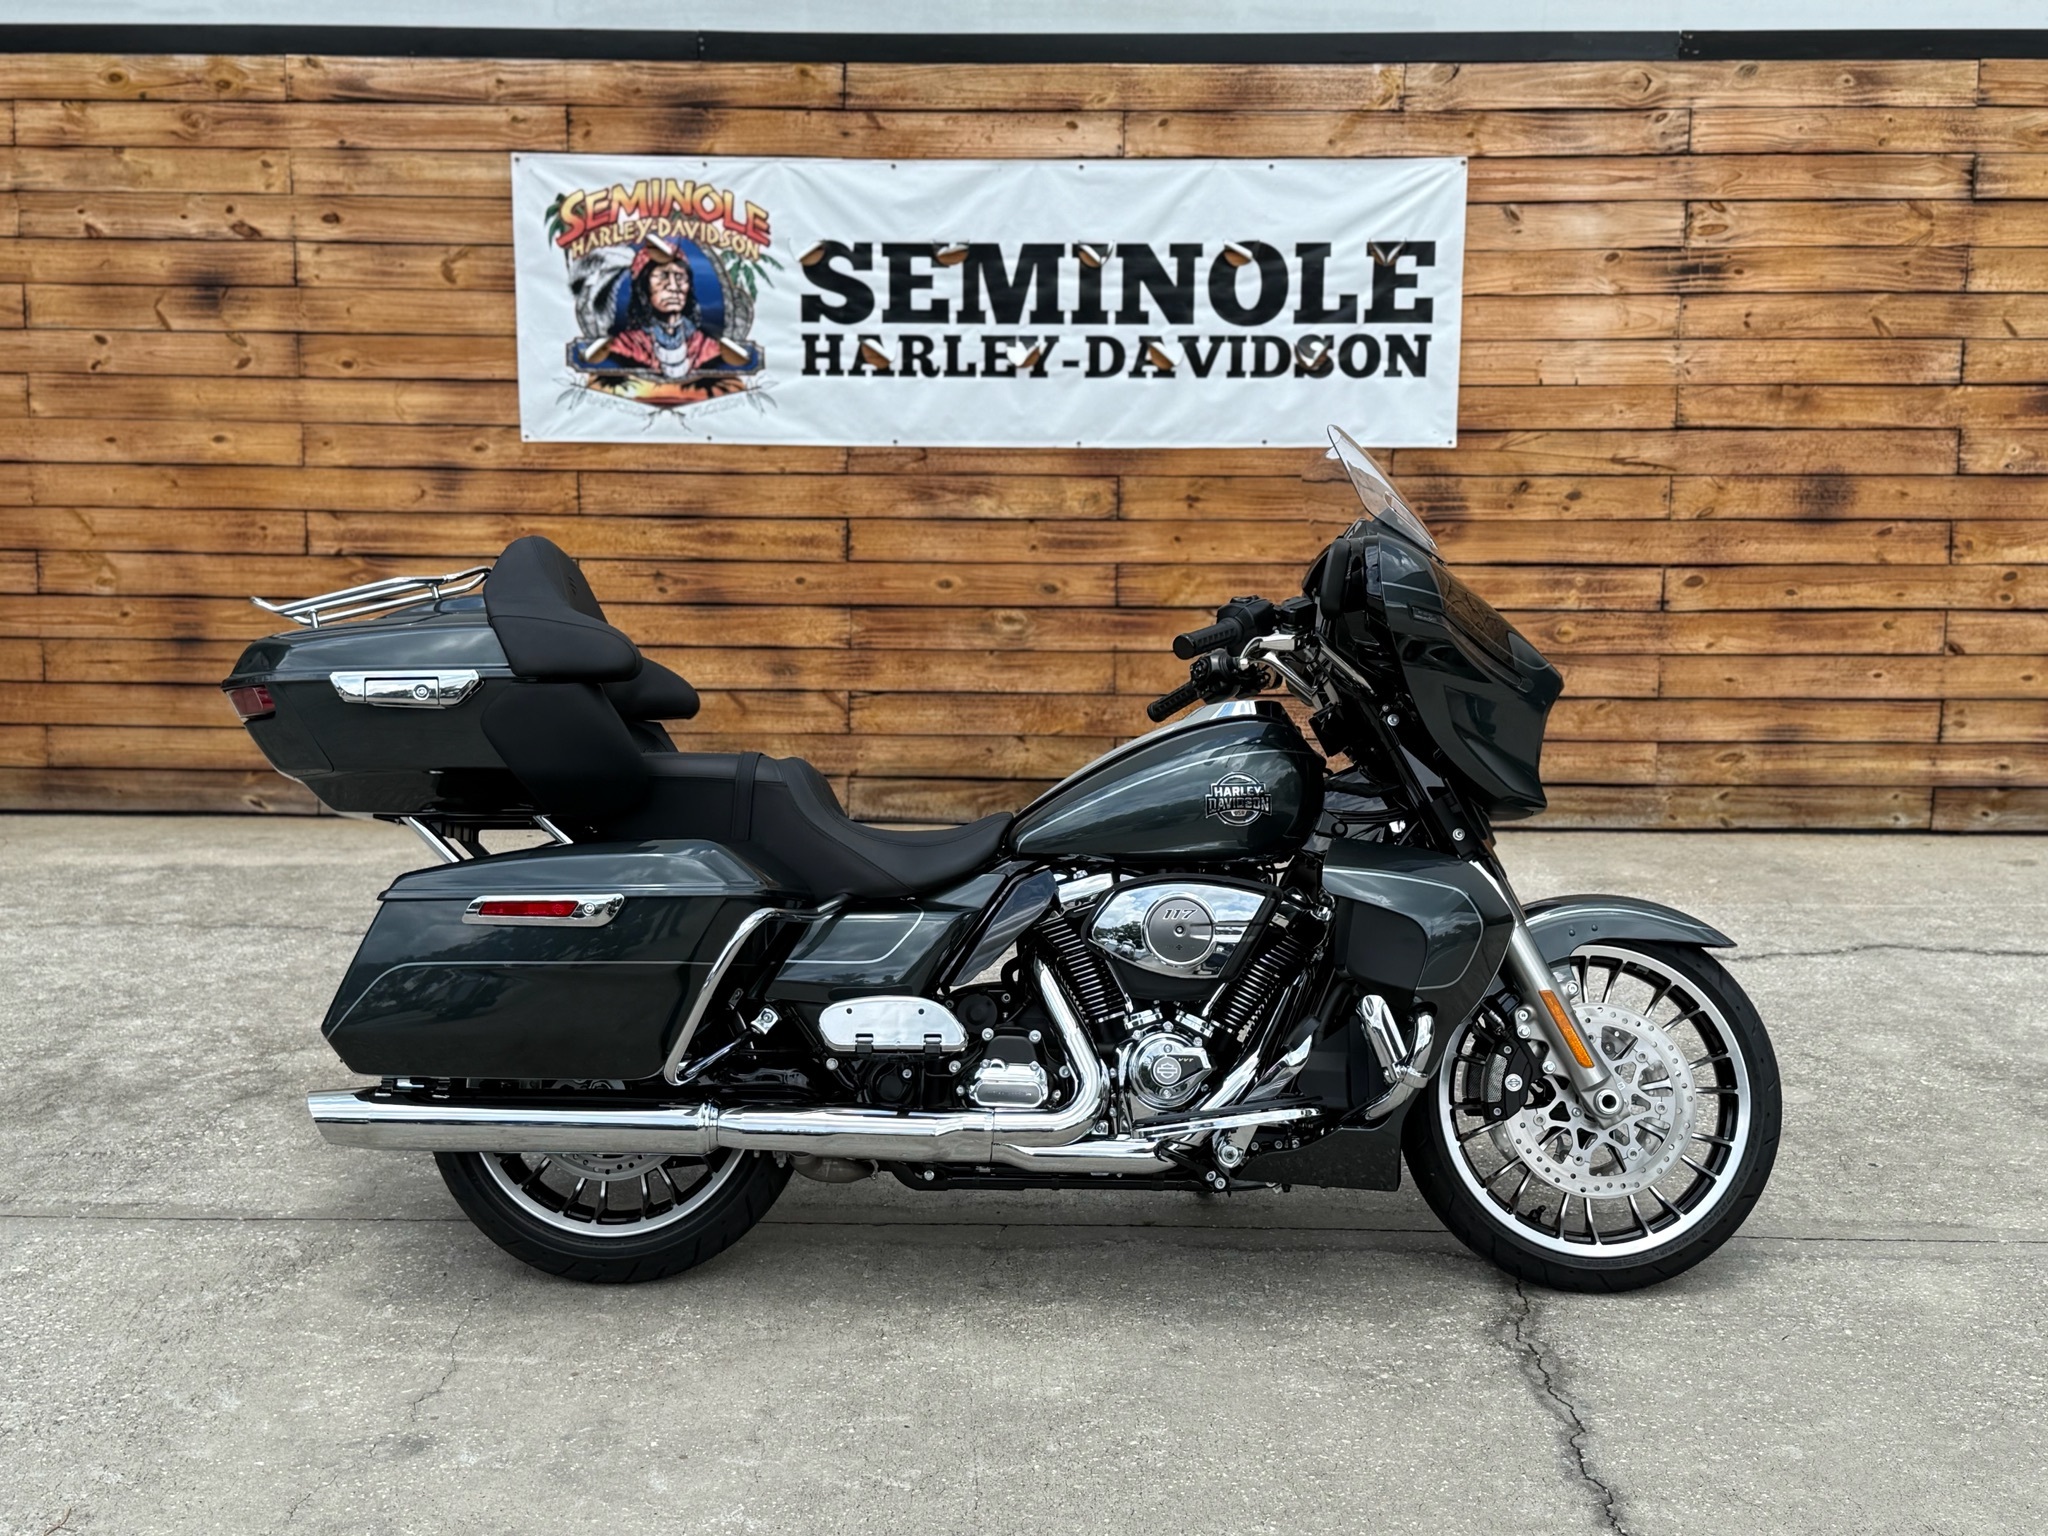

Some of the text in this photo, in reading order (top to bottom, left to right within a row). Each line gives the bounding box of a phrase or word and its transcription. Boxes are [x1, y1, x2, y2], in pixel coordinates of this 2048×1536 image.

[556, 178, 770, 247] SEMINOLE
[571, 217, 760, 261] HARLEY-DAVIDSON
[801, 240, 1436, 326] SEMINOLE
[801, 333, 1432, 379] HARLEY-DAVIDSON
[1208, 796, 1270, 813] DAVIDSON
[1162, 908, 1197, 920] 117
